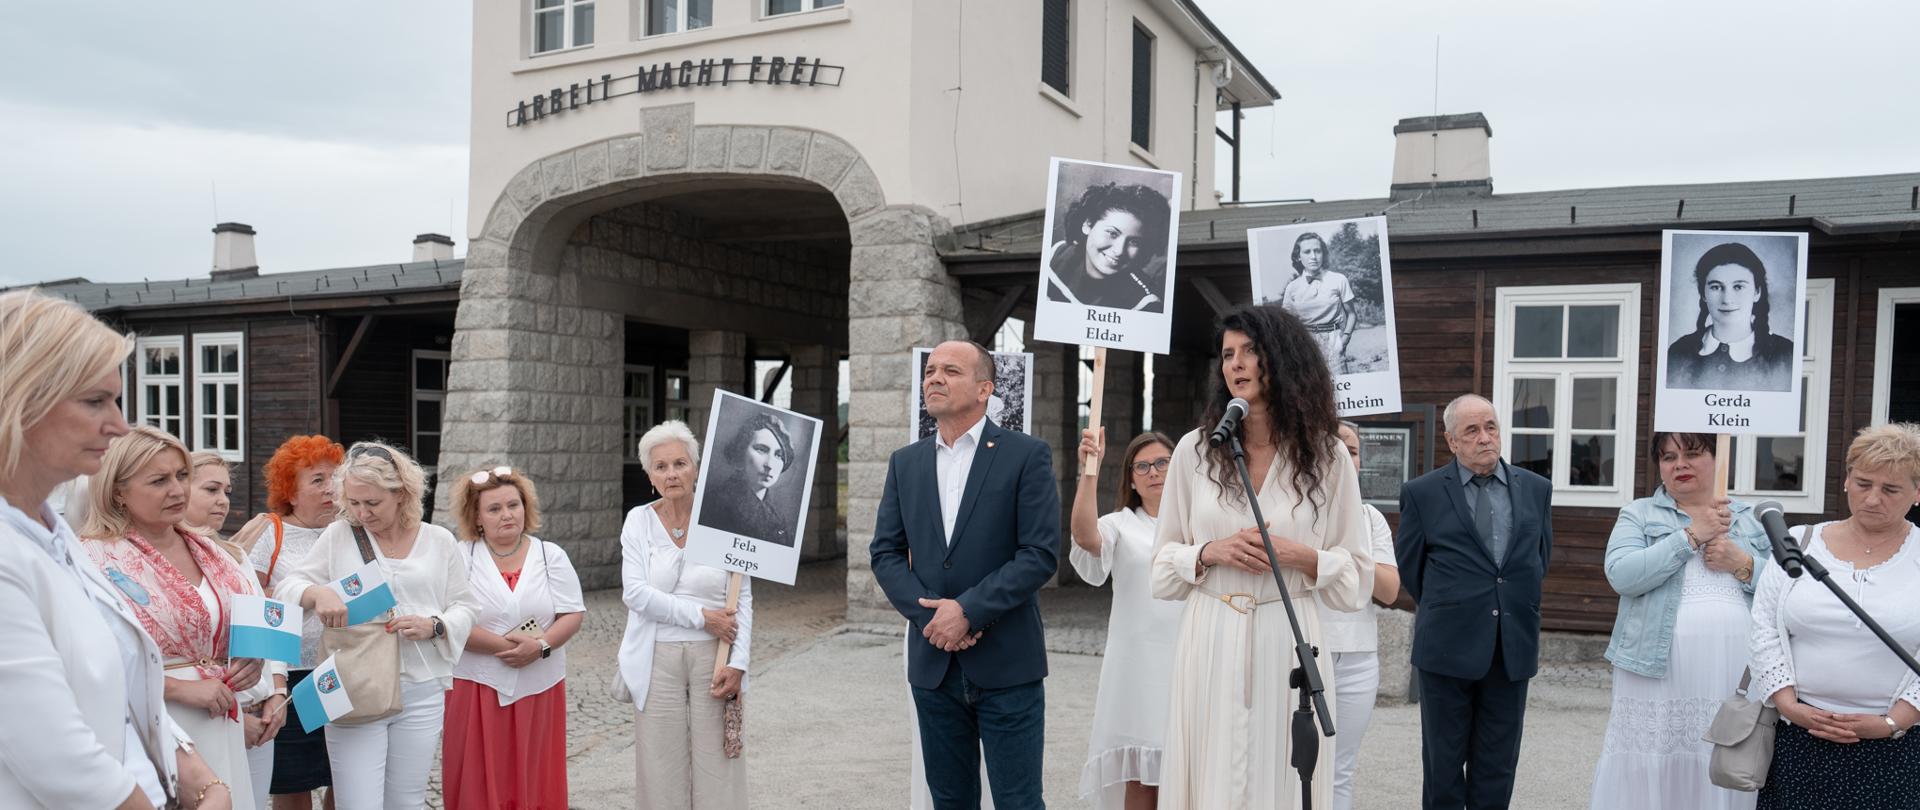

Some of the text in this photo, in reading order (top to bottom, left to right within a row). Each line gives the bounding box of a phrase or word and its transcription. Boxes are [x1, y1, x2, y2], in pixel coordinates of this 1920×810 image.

[517, 56, 821, 127] ARBEIT MACHT FREI
[1086, 308, 1122, 324] Ruth
[1086, 327, 1124, 342] Eldar
[1332, 379, 1351, 391] ice
[1337, 395, 1384, 410] nheim
[1704, 393, 1751, 407] Gerda
[1708, 413, 1750, 427] Klein
[732, 537, 757, 553] Fela
[724, 553, 759, 572] Szeps
